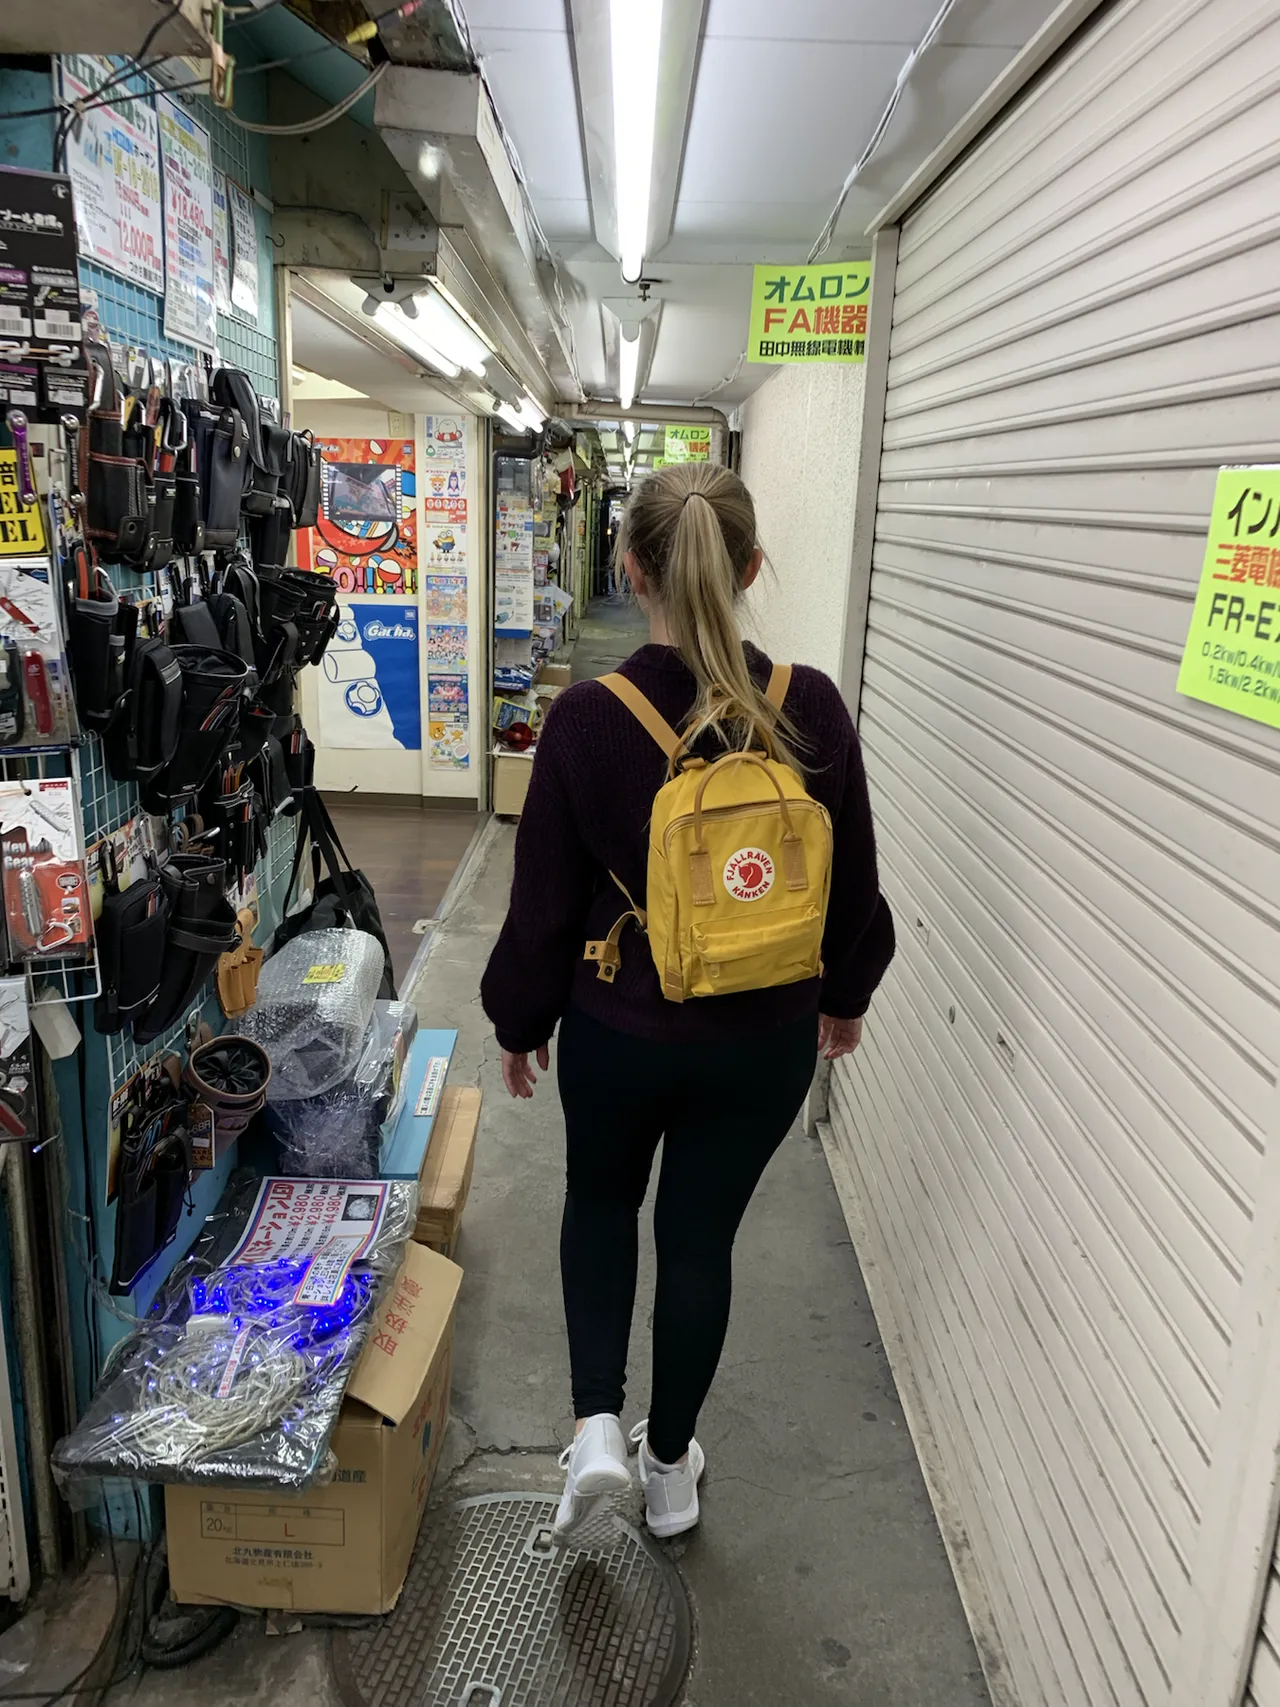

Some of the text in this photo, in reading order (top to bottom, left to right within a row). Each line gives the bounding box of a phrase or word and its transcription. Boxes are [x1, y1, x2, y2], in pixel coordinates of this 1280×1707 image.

[764, 274, 870, 303] オムロン
[763, 304, 868, 335] FA機器
[670, 429, 710, 440] オムロン
[4, 855, 35, 869] Gear
[286, 1194, 310, 1227] ¥2,980
[304, 1194, 327, 1226] ¥2,980
[321, 1194, 343, 1225] ¥4,980
[372, 1275, 424, 1357] 取扱注意
[284, 1522, 296, 1538] L
